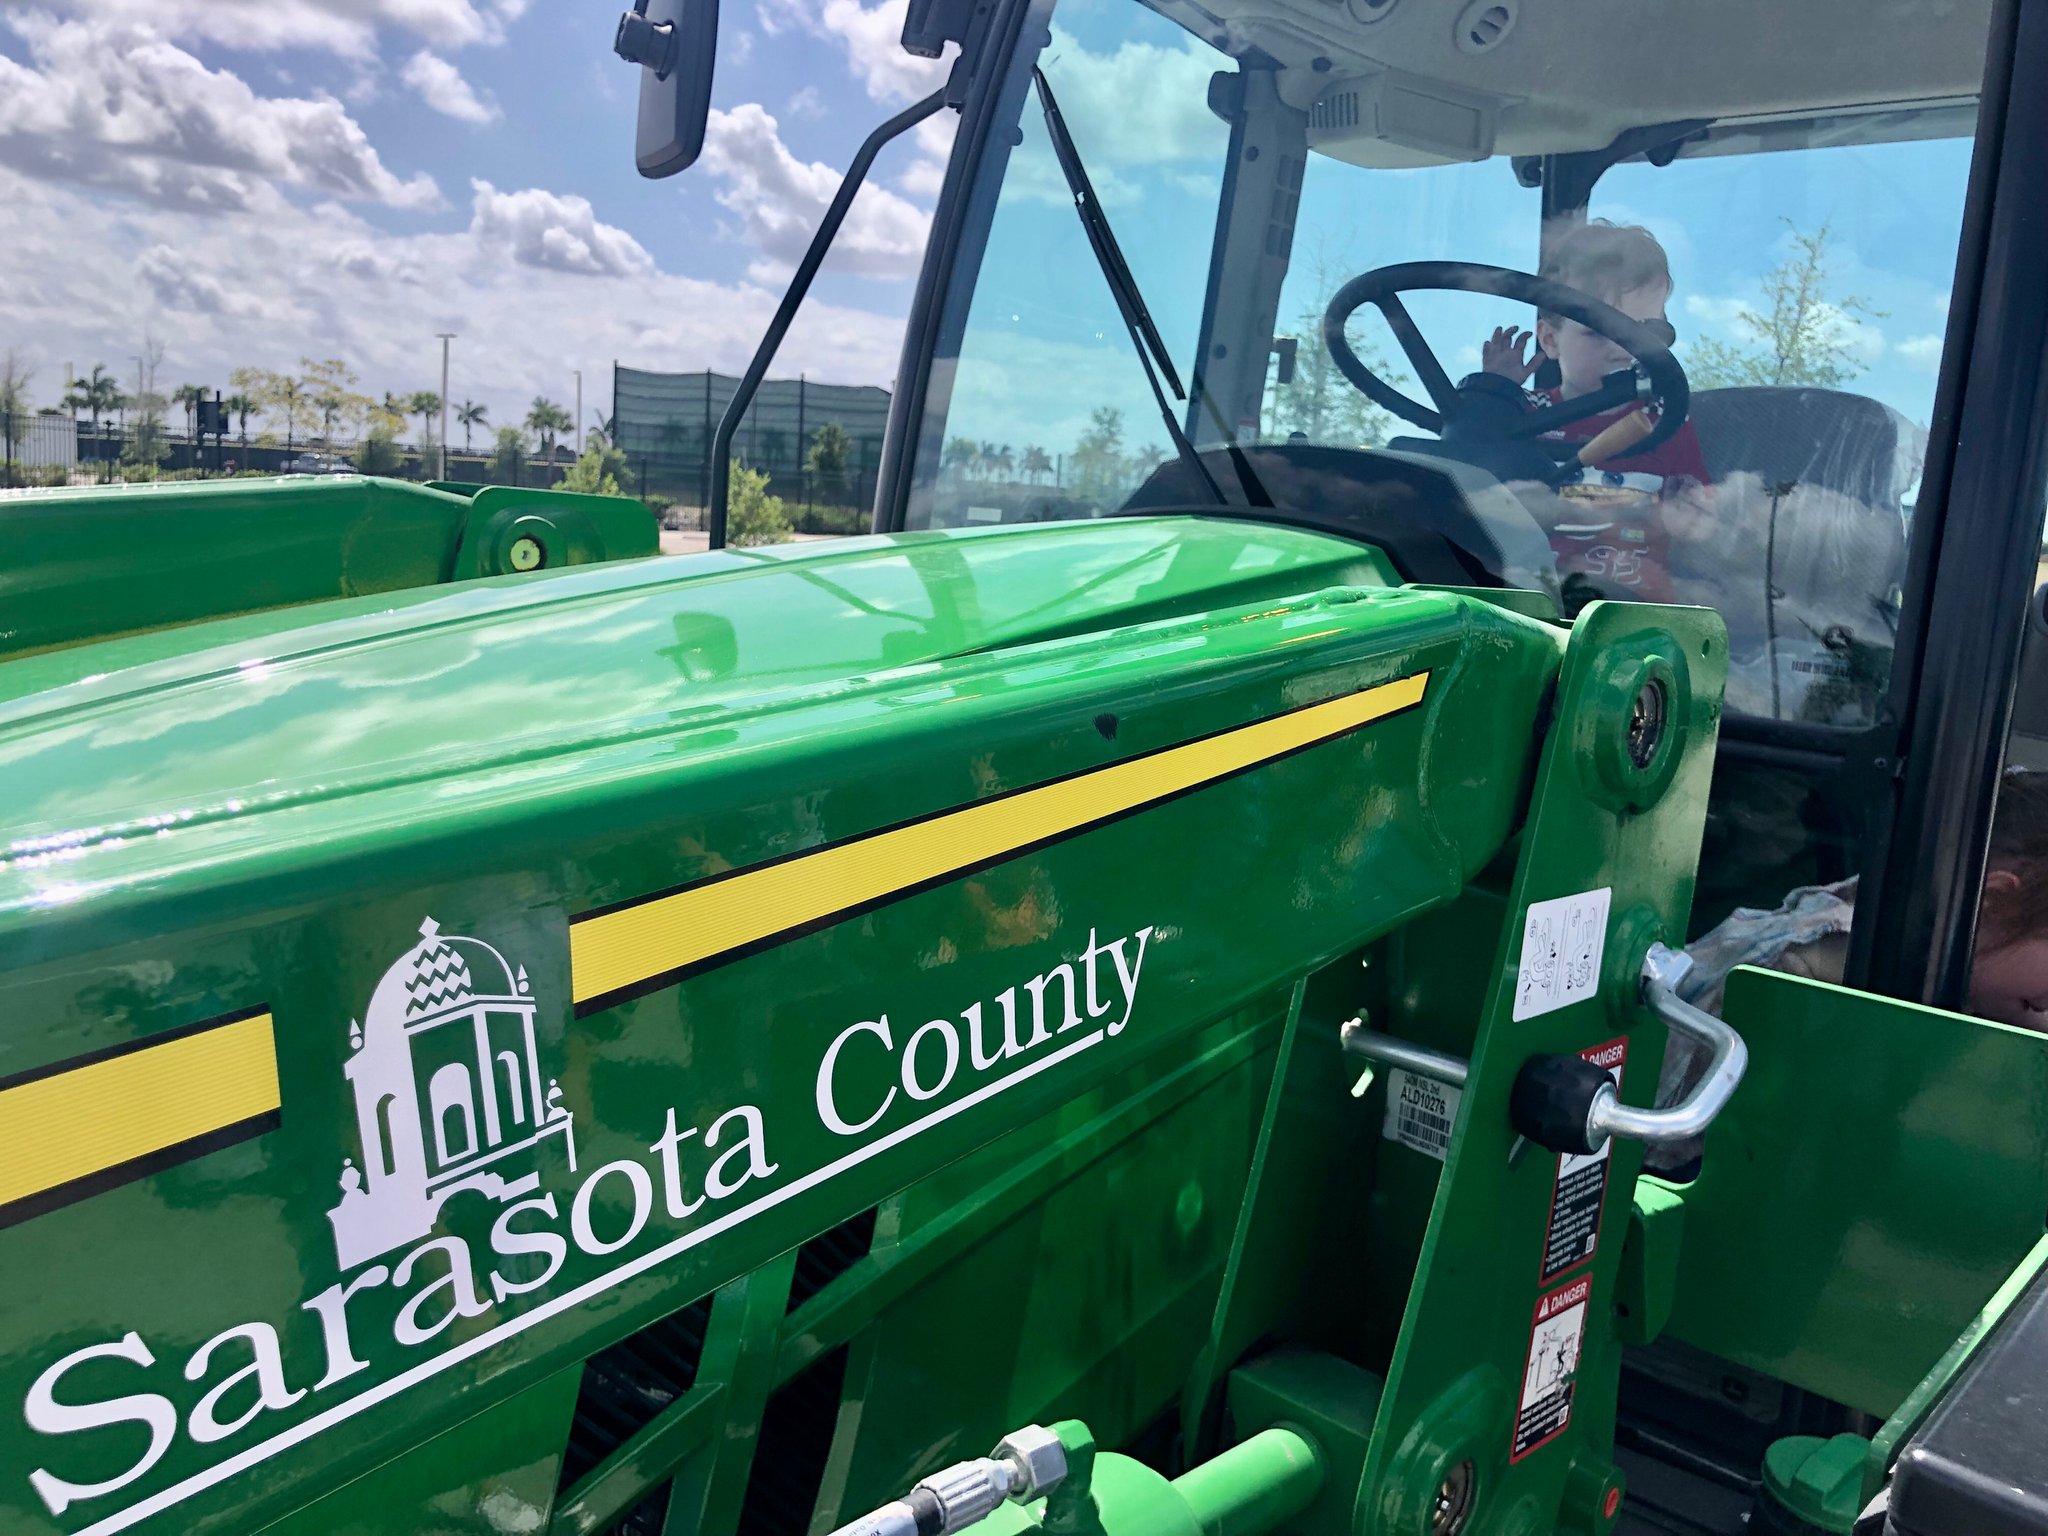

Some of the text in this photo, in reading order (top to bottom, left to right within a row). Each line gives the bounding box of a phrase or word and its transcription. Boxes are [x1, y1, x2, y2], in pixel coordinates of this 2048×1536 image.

[1588, 1044, 1624, 1066] DANGER
[1400, 1086, 1446, 1115] ALD10276
[24, 926, 1154, 1517] Sarasota County
[1551, 1282, 1587, 1311] DANGER
